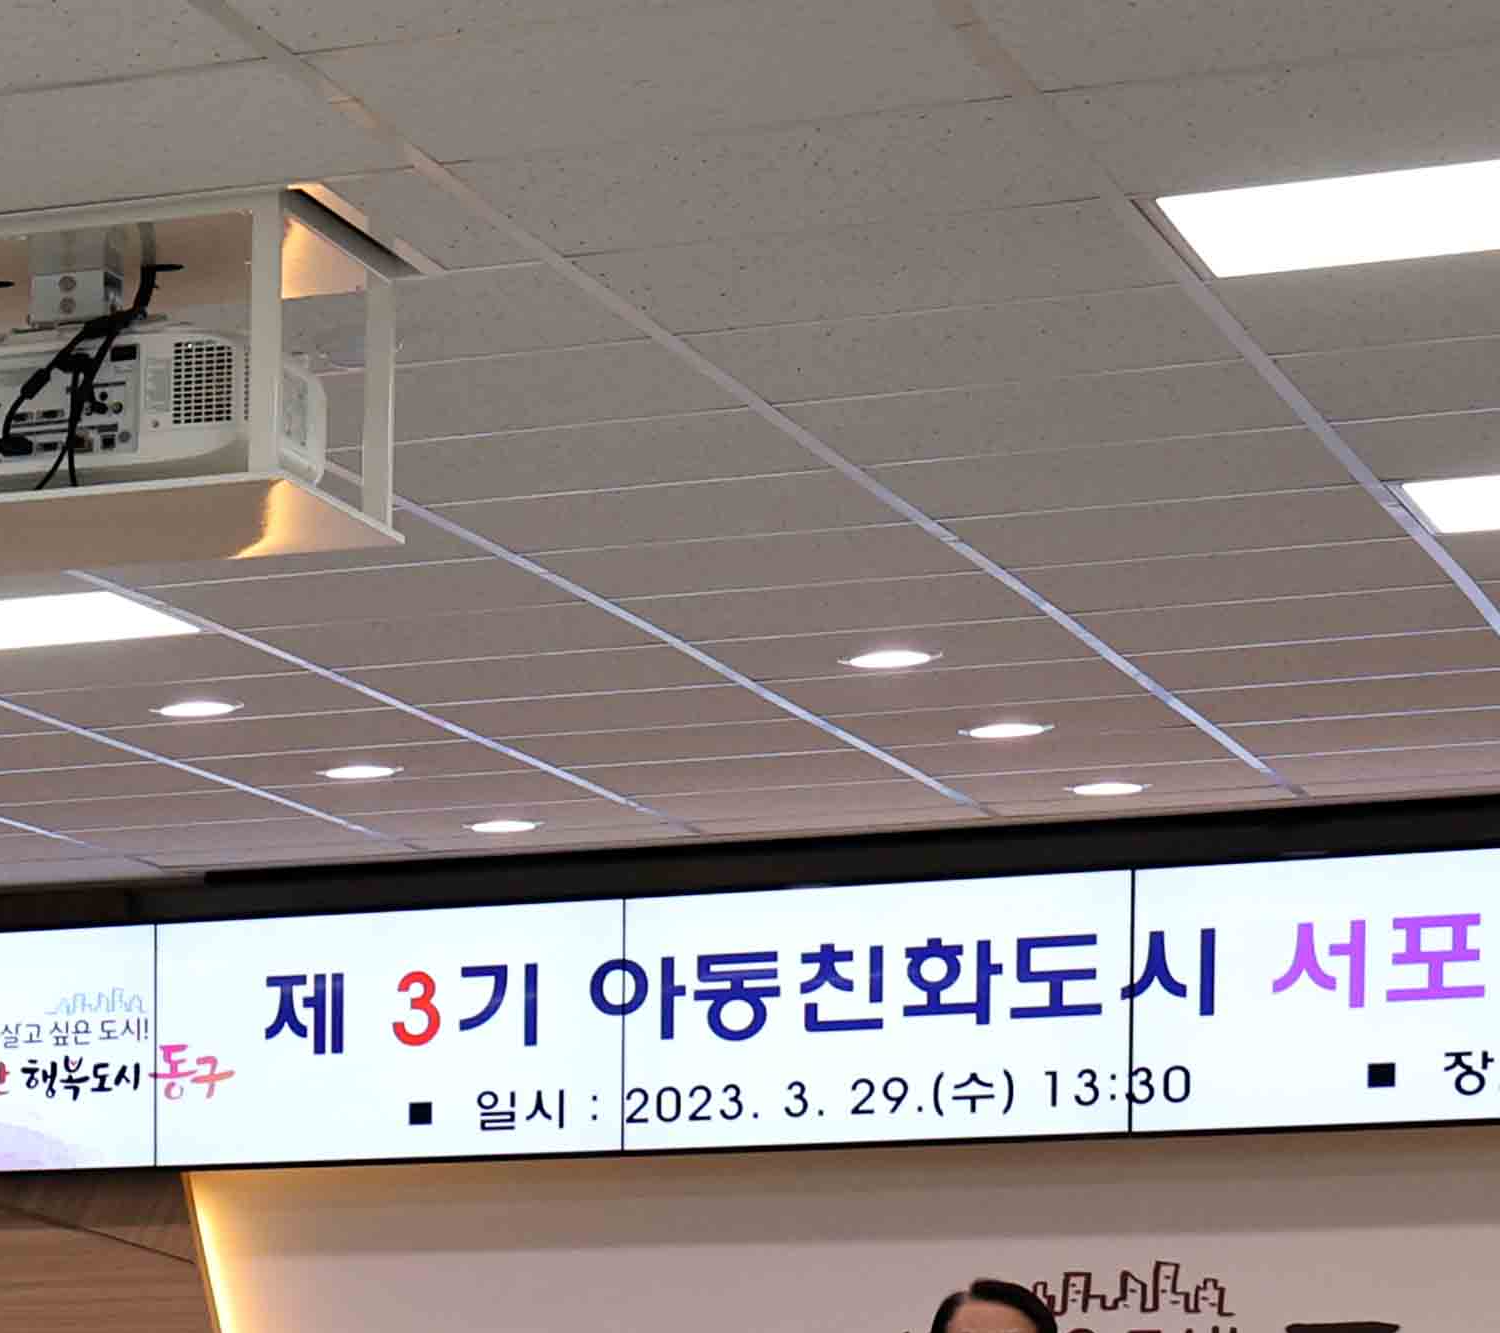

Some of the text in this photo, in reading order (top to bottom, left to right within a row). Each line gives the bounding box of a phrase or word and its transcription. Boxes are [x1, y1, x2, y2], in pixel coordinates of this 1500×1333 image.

[264, 913, 1486, 1055] 제 3기 아동친화도시 서포
[1, 1017, 149, 1049] 살고 싶은 도시!
[20, 1055, 141, 1101] 행복도시
[148, 1044, 236, 1100] 동구
[476, 1088, 565, 1131] 일시
[625, 1083, 759, 1124] 2023.
[784, 1080, 825, 1118] 3.
[850, 1069, 1015, 1117] 29.(수)
[1044, 1065, 1192, 1108] 13:30
